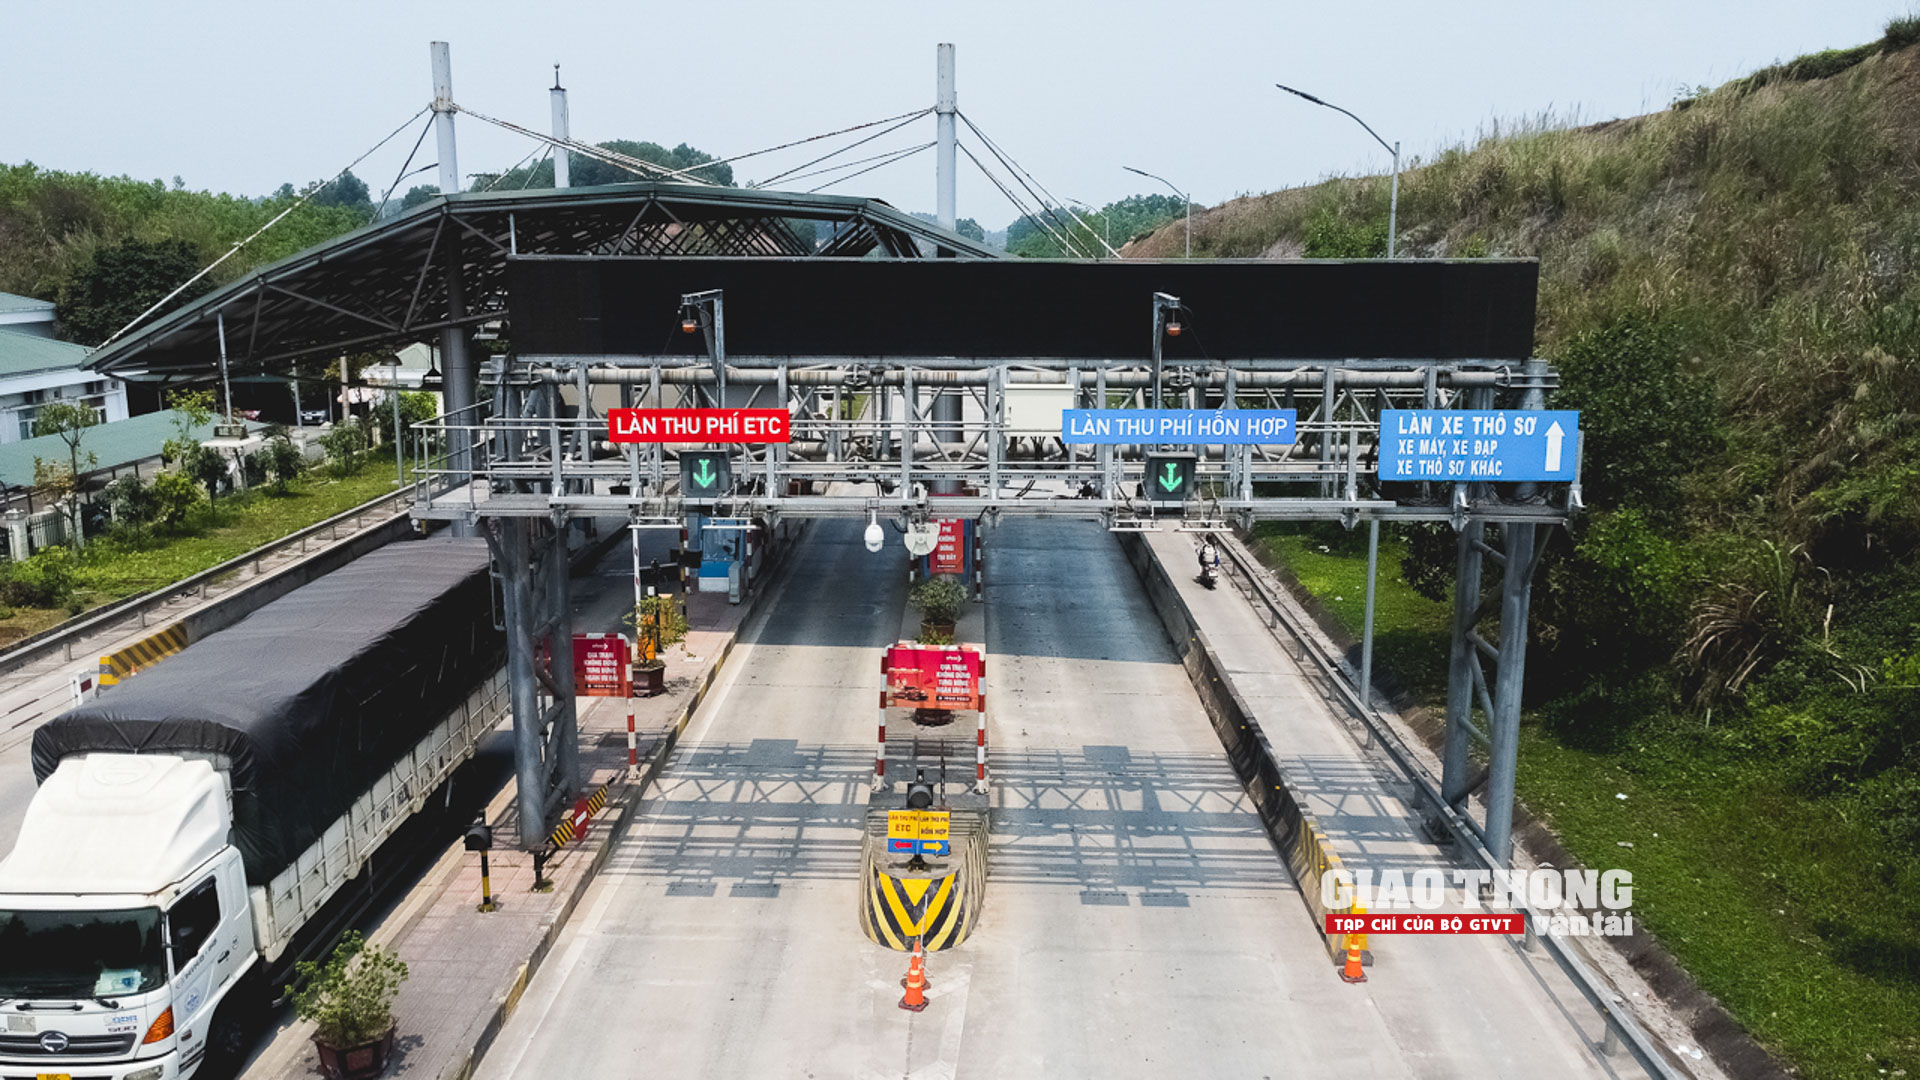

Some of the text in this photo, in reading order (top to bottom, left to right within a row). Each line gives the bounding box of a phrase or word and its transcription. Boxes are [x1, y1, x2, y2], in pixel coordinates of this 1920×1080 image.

[616, 412, 782, 435] LÀN THU PHÍ ETC
[1070, 410, 1288, 439] LÀN THU PHÍ HỖN HỢP
[1398, 411, 1538, 436] LÀN XE THÔ SƠ
[1398, 437, 1498, 458] XE MÁY, XE ĐẠP
[1396, 456, 1503, 476] XE THÔ SƠ KHÁC
[895, 824, 911, 832] ETC
